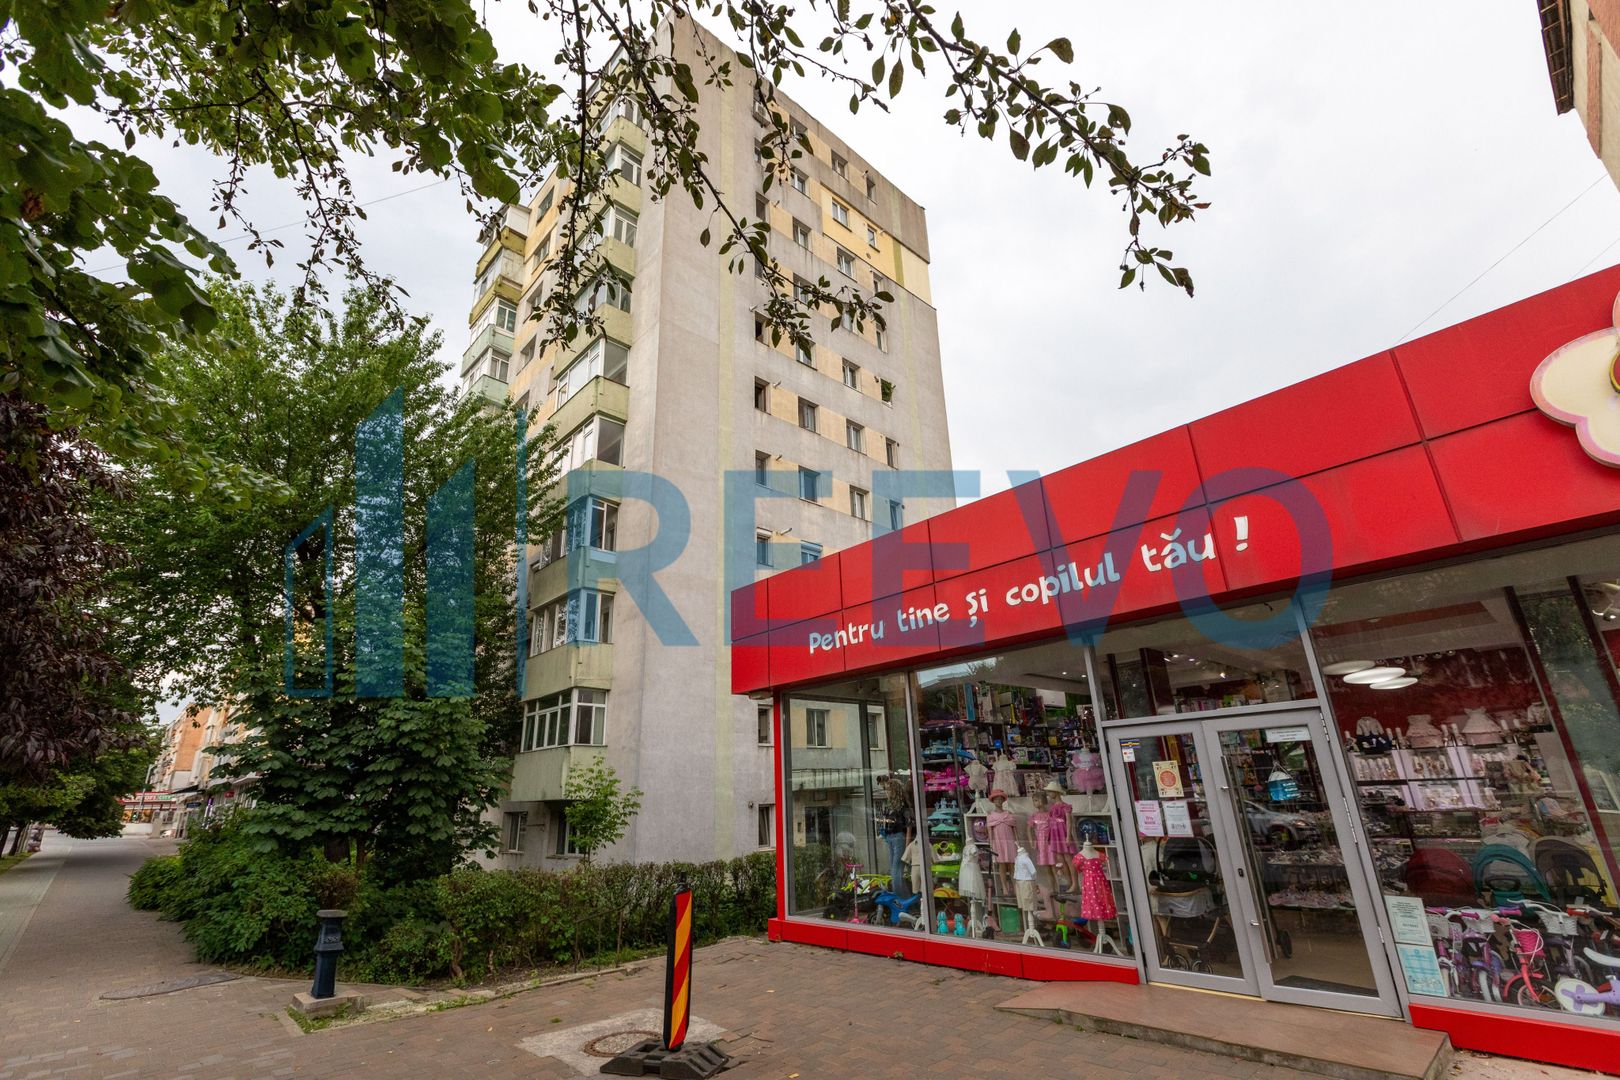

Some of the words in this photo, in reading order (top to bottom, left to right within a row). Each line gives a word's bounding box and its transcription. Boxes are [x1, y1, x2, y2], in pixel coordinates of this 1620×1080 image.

[809, 619, 885, 655] Pentru
[897, 603, 951, 633] tine
[1005, 552, 1121, 606] copilul
[1140, 527, 1217, 573] tău
